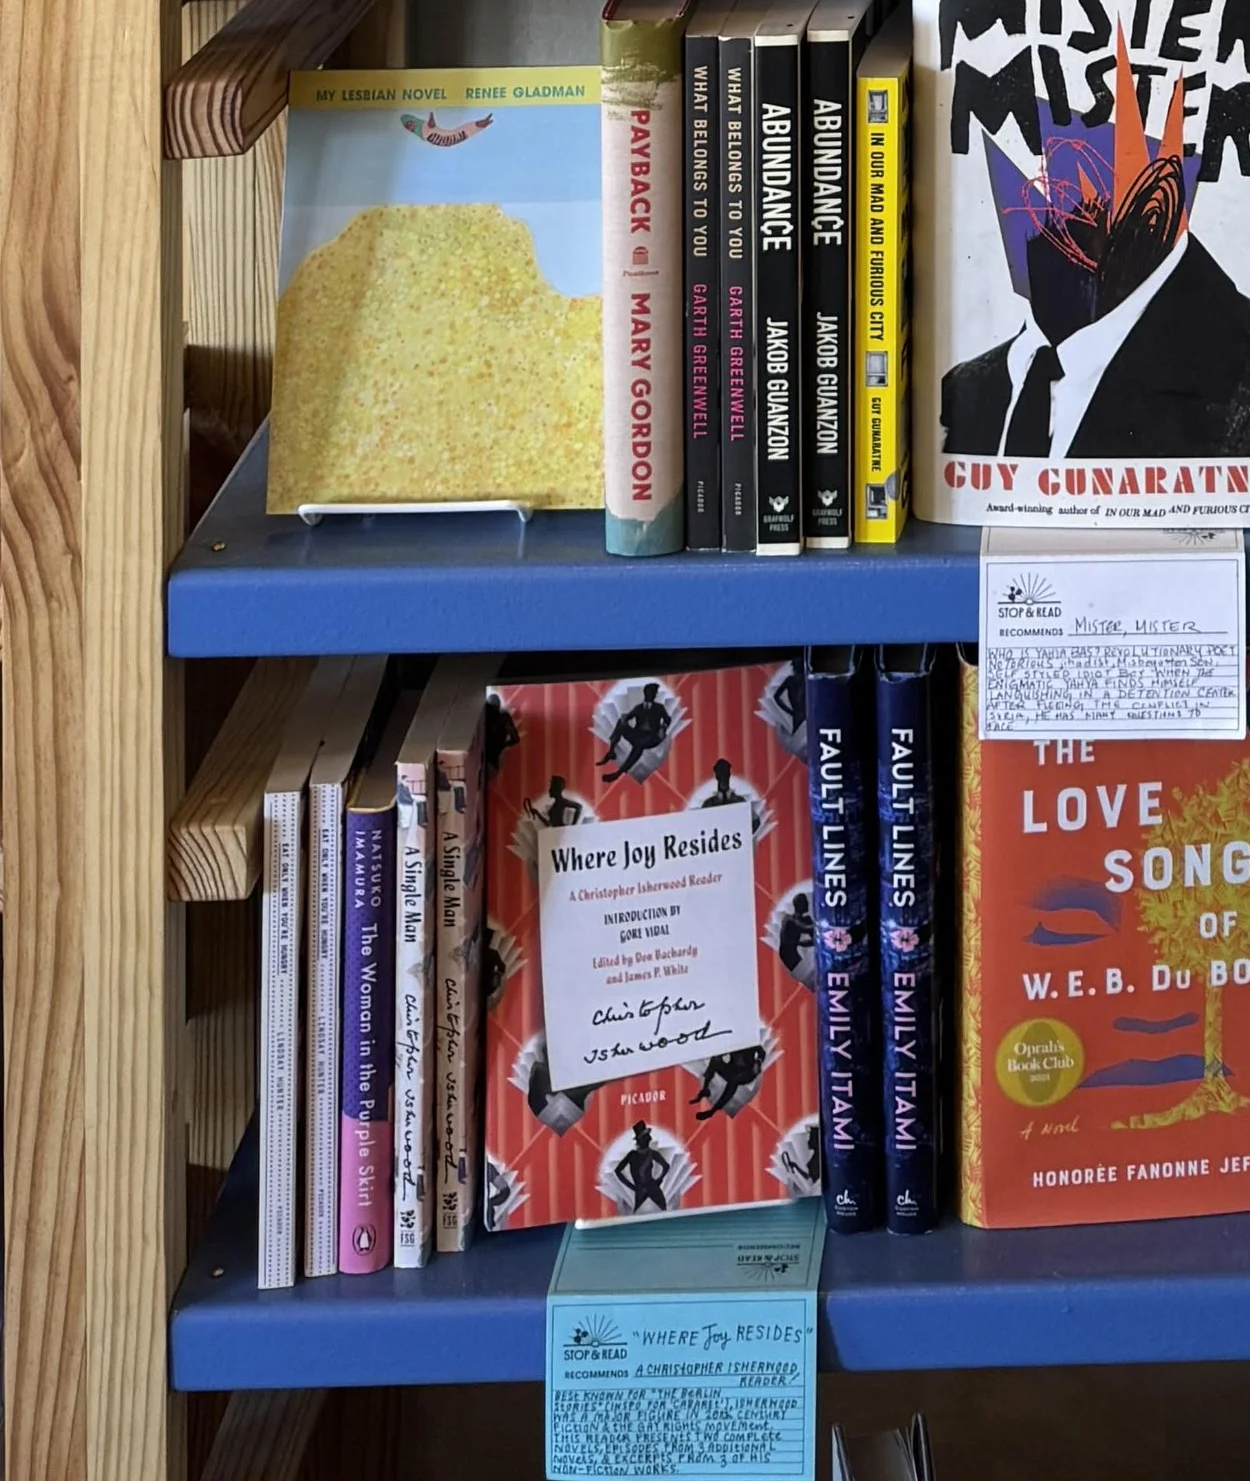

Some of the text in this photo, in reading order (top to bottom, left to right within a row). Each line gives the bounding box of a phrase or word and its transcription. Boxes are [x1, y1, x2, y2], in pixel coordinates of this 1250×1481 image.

[317, 84, 585, 102] MY LESBIAN NOVEL RENEE GLADMAN
[629, 108, 653, 501] PAYBACK MARY GORDON
[944, 461, 1018, 492] GUY
[986, 503, 1053, 514] Award-winning
[1058, 505, 1088, 515] author
[1090, 505, 1100, 515] of
[1105, 509, 1117, 517] IN
[1119, 509, 1140, 517] OUR
[1142, 509, 1166, 517] MAD
[1168, 505, 1190, 514] AND
[1192, 505, 1237, 515] FURIOUS
[1034, 740, 1095, 766] THE
[1022, 781, 1164, 835] LOVE
[552, 828, 743, 873] Where Joy Resides
[891, 727, 917, 1151] FAULT LINES EMILY ITAMI
[1198, 911, 1238, 939] OF
[1127, 1159, 1209, 1181] FANONNE
